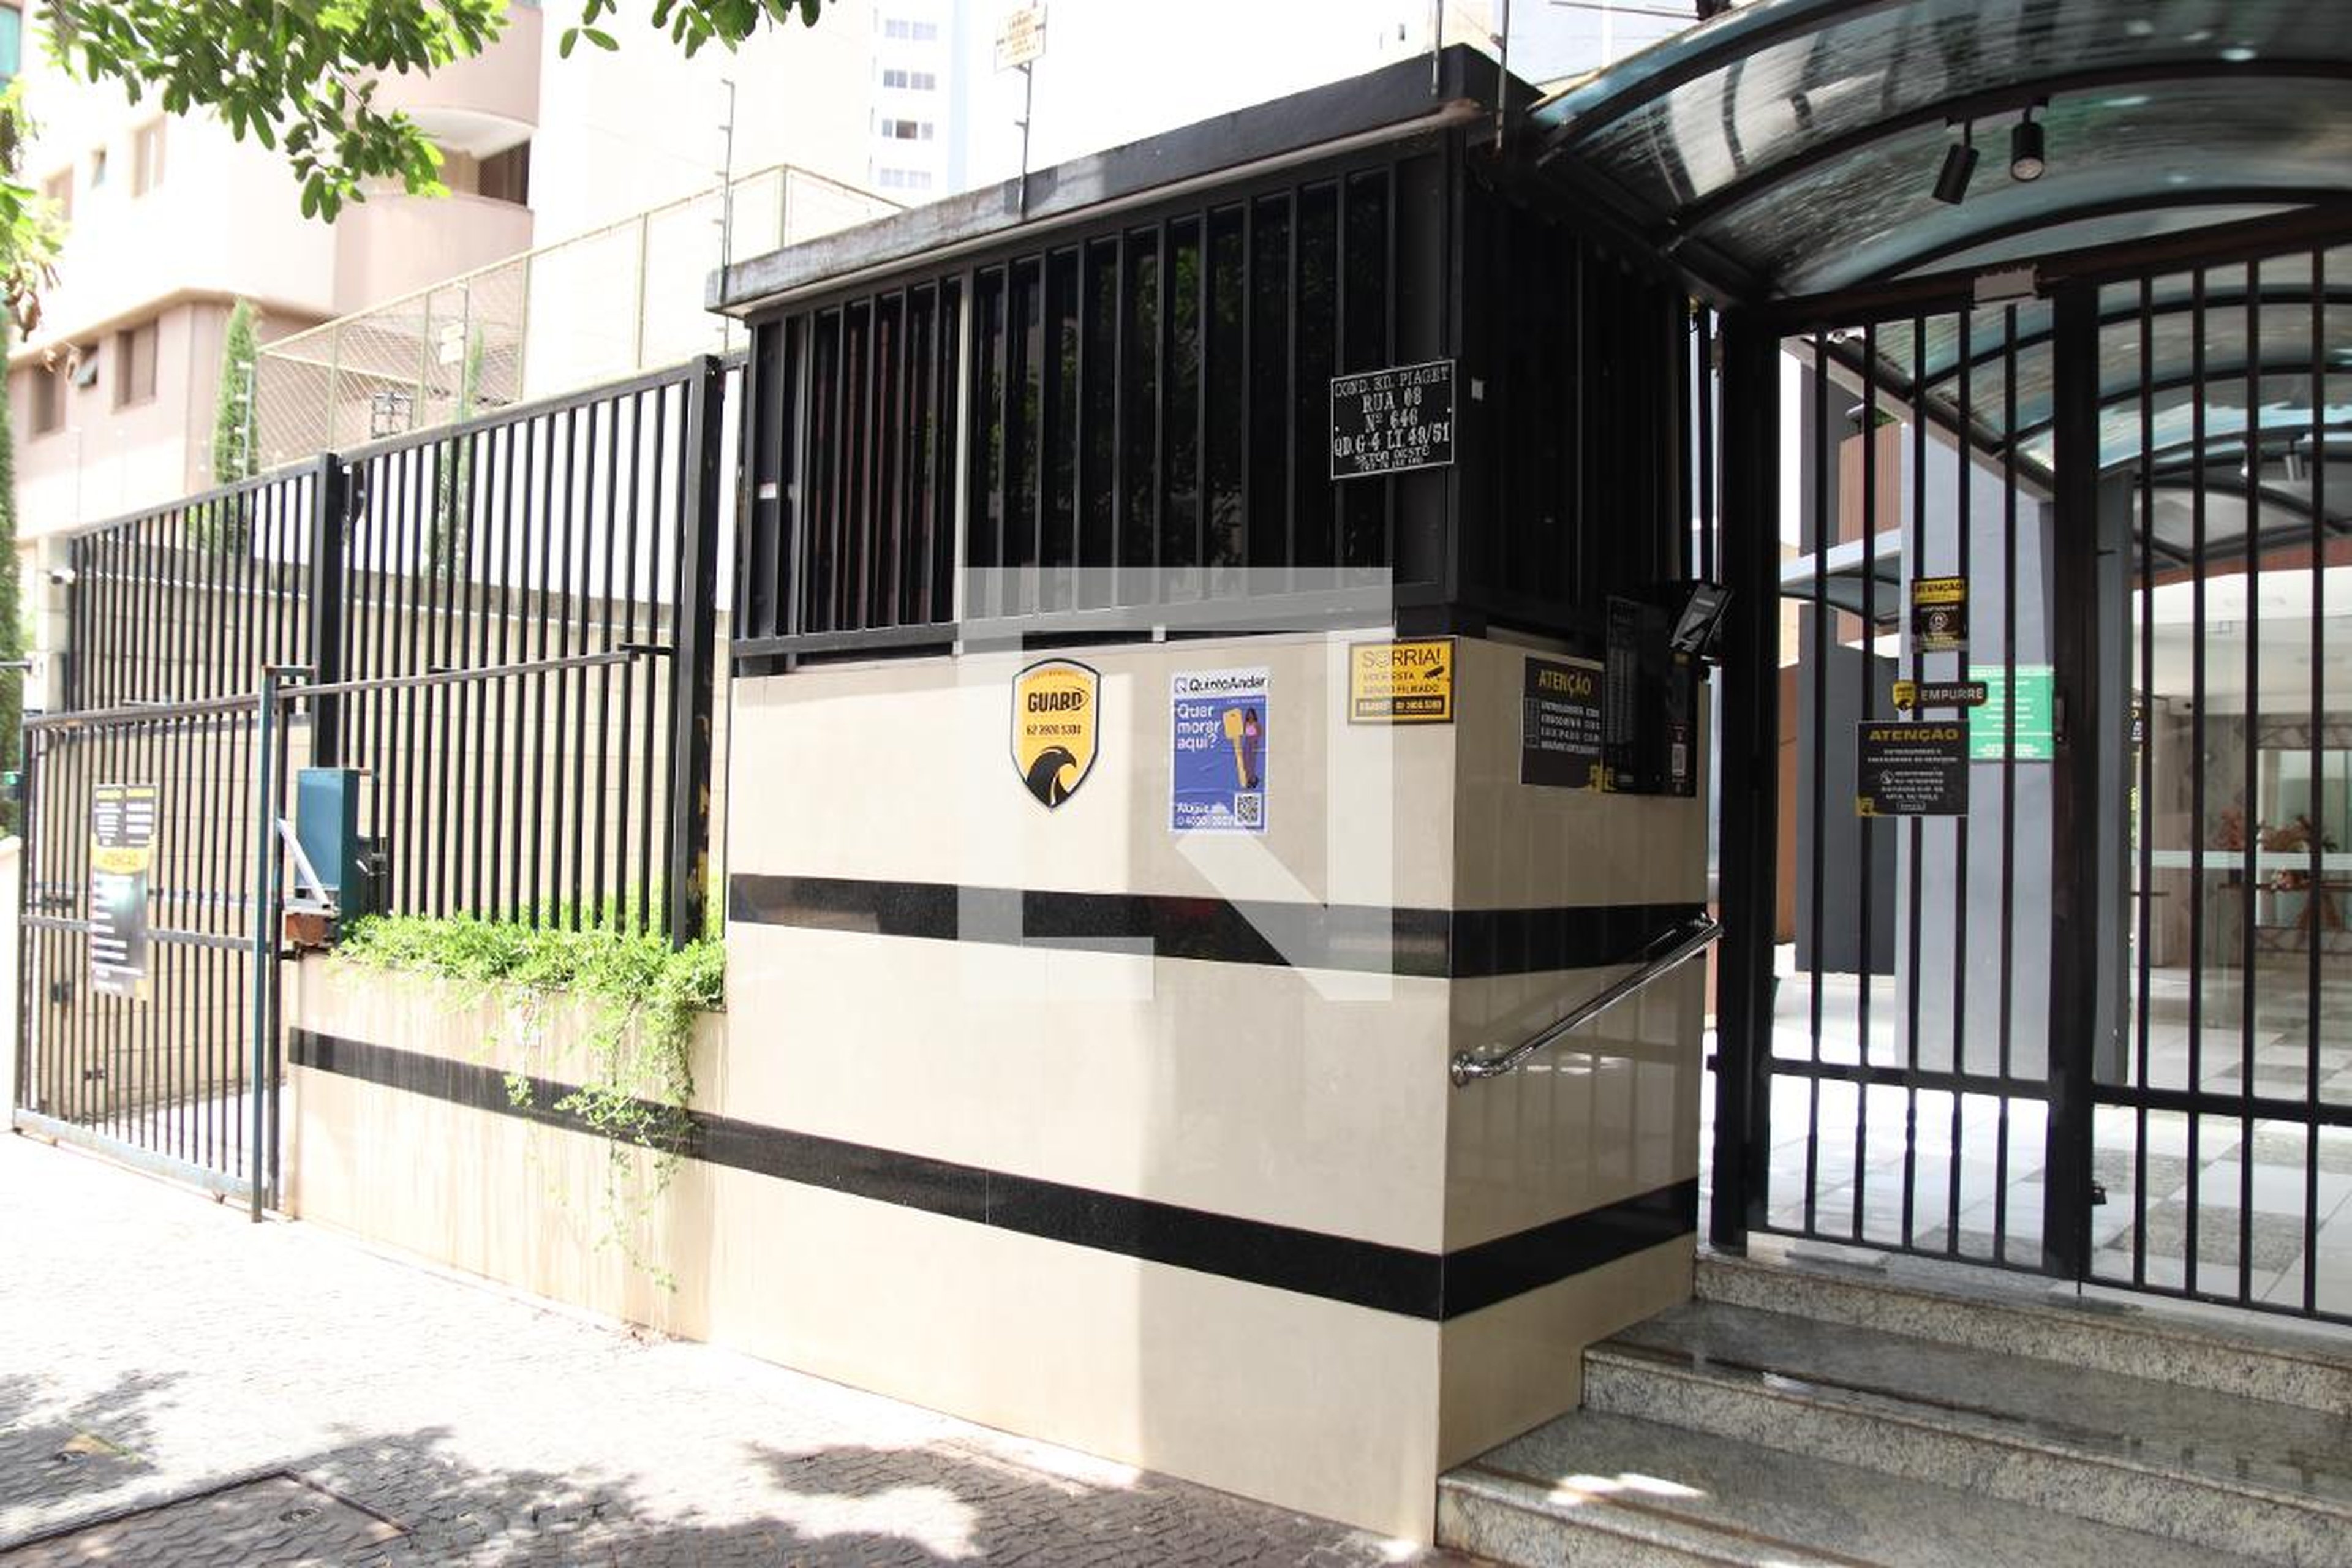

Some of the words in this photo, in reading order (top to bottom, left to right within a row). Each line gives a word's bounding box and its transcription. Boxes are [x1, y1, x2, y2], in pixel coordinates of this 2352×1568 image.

[1400, 366, 1449, 386] PIAGET
[1363, 391, 1395, 413] RUA
[1404, 386, 1422, 407] 08
[1362, 647, 1441, 668] SORRIA!
[1189, 676, 1266, 693] QuintoAndar
[1920, 687, 1985, 701] EMPURRE
[1028, 691, 1083, 712] GUARD
[1177, 703, 1214, 719] Quer
[1177, 720, 1221, 734] morar
[1177, 733, 1218, 752] aqui?
